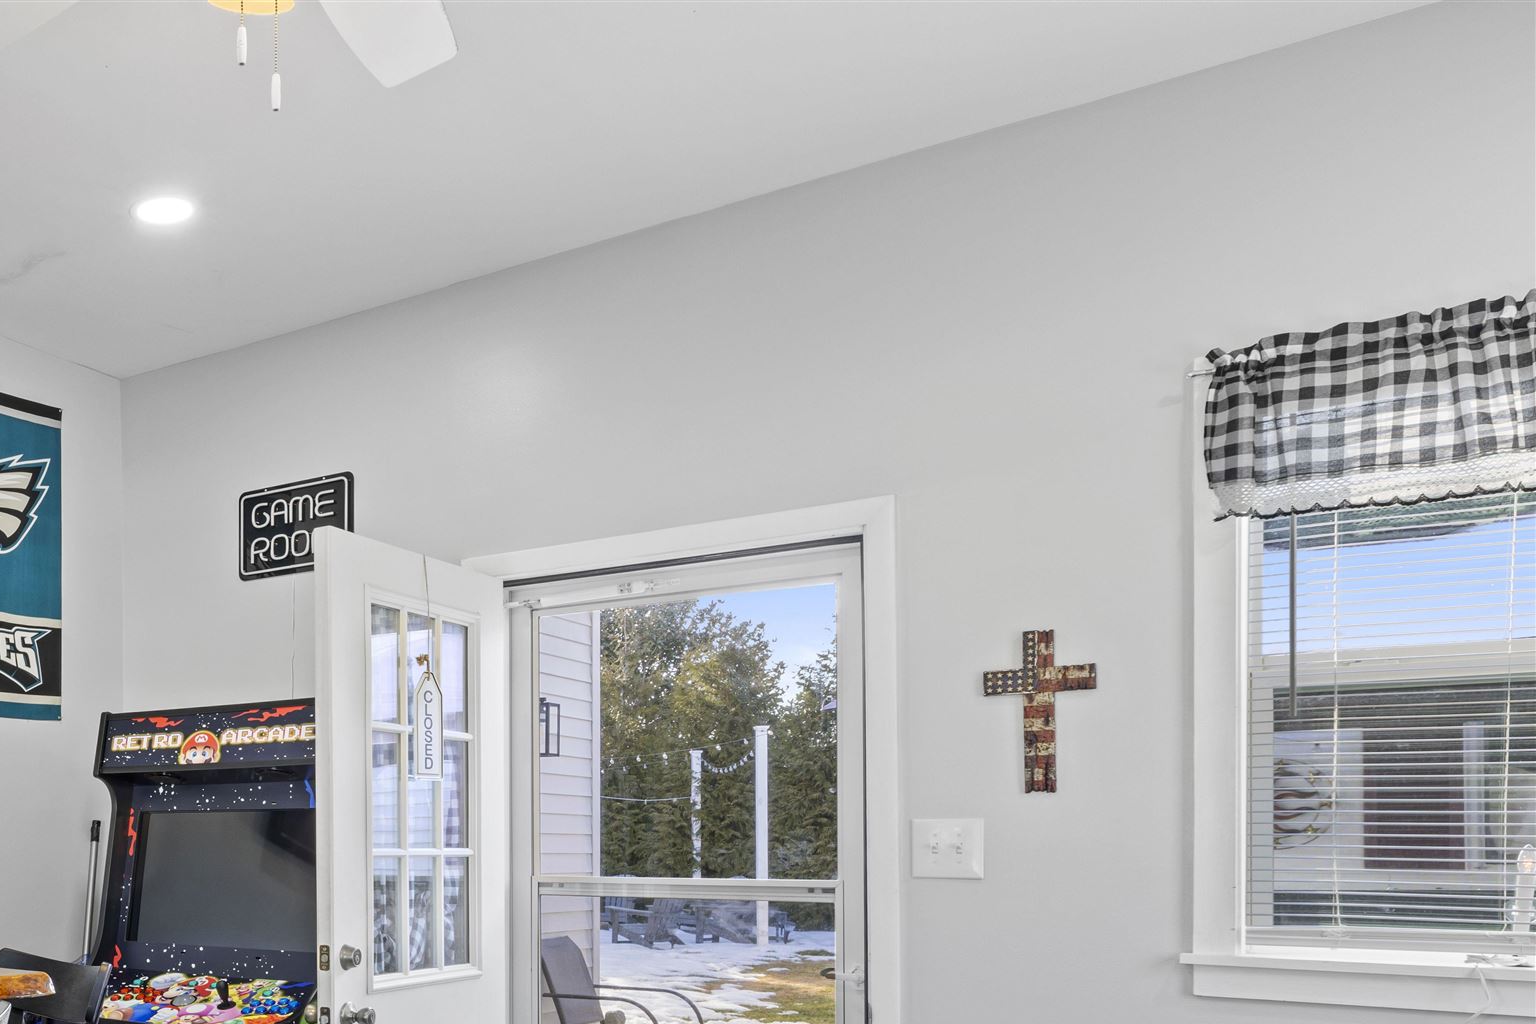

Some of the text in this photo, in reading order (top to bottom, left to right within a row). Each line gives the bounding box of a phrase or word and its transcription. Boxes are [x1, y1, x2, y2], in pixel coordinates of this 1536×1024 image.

[251, 488, 335, 529] GAME
[250, 529, 314, 564] ROO
[112, 723, 317, 751] RETRO ARCADE
[423, 690, 434, 770] CLOSED
